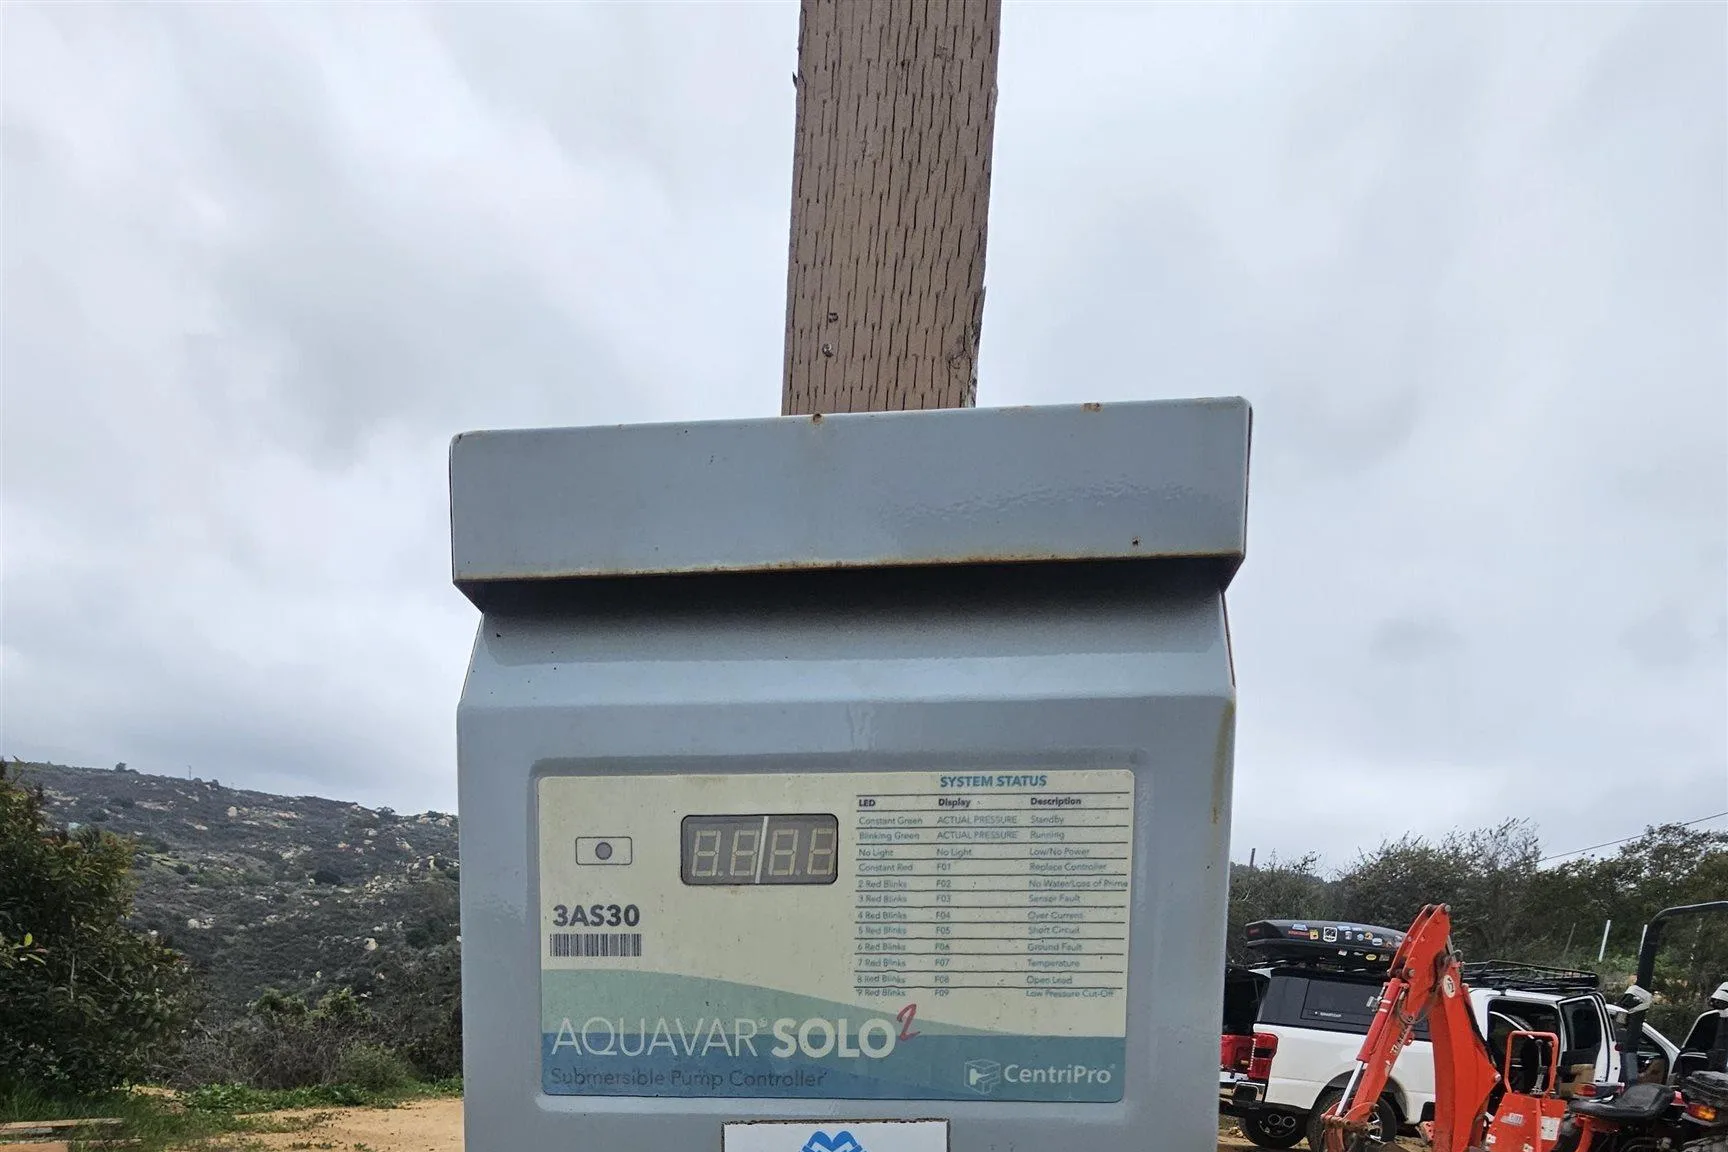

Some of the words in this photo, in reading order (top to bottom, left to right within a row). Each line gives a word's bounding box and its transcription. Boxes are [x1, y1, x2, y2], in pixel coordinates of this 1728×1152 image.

[940, 776, 993, 787] SYSTEM
[997, 776, 1047, 786] STATUS
[939, 798, 971, 808] Display
[1030, 797, 1081, 807] Description
[859, 817, 895, 825] Constant
[898, 816, 923, 824] Green
[936, 816, 971, 824] ACTUAL
[974, 816, 1017, 824] PRESSURE
[1031, 815, 1064, 824] Standby
[860, 832, 892, 841] Blinking
[895, 832, 920, 840] Green
[936, 831, 971, 839] ACTUAL
[974, 831, 1018, 839] PRESSURE
[1030, 831, 1065, 840] Running
[873, 849, 893, 858] Light
[951, 848, 972, 857] Light
[1029, 863, 1062, 872] Replace
[866, 880, 881, 888] Red
[884, 880, 907, 888] Blinks
[553, 904, 640, 927] 3AS30
[1028, 926, 1049, 934] Short
[1052, 926, 1080, 934] Circuit
[1028, 943, 1059, 951] Ground
[1028, 959, 1080, 968] Temperature
[1027, 976, 1049, 984] Open
[552, 1016, 759, 1057] AQUAVAR
[772, 1018, 896, 1058] SOLO
[897, 1004, 920, 1041] 2
[552, 1068, 664, 1086] Submersible
[671, 1070, 723, 1090] Pump
[730, 1070, 823, 1087] Controller
[1004, 1065, 1112, 1084] CentriPro
